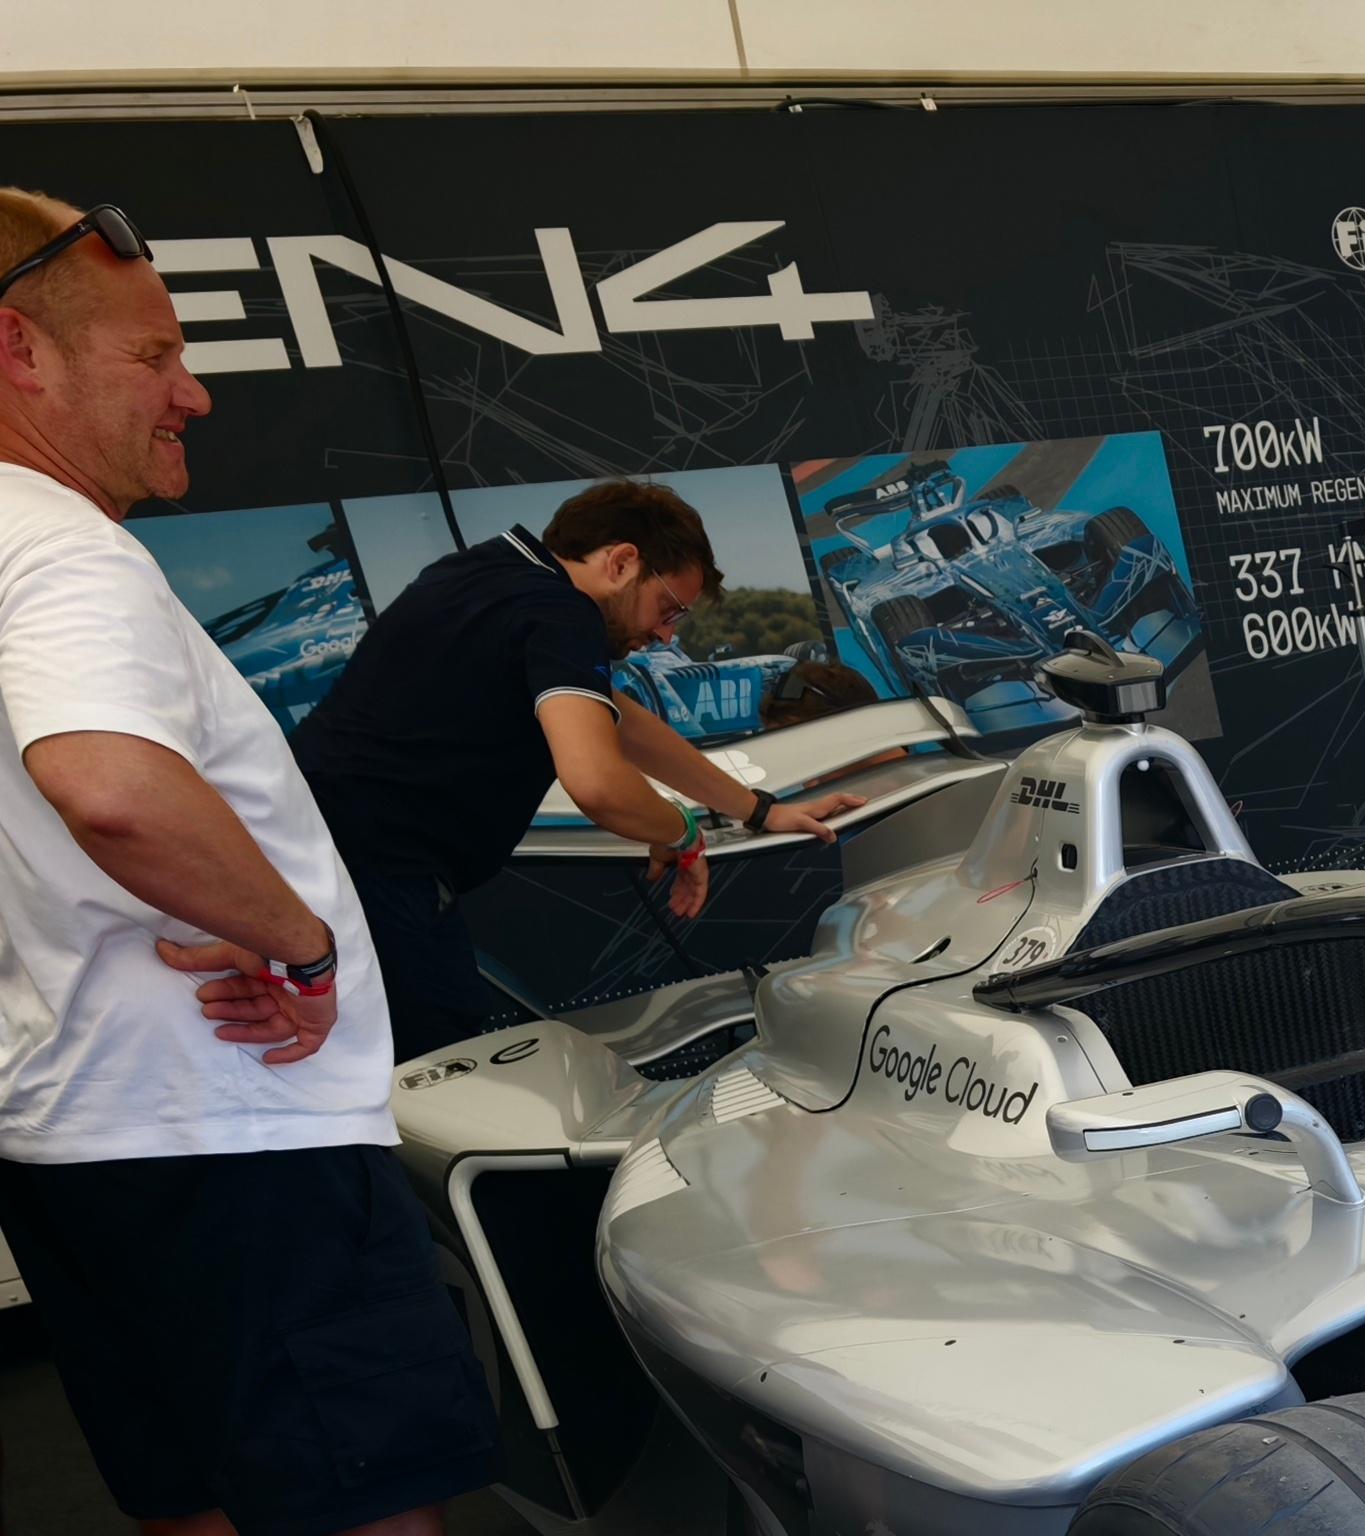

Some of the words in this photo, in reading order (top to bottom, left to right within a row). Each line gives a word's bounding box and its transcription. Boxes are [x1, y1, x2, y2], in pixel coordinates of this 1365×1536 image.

[876, 480, 909, 500] ABB
[1216, 483, 1302, 515] MAXIMUM
[1229, 548, 1305, 602] 337
[694, 678, 752, 722] ABB
[1016, 777, 1072, 813] DHL
[1002, 936, 1047, 968] 379
[869, 1025, 942, 1101] Google
[945, 1057, 1039, 1125] Cloud
